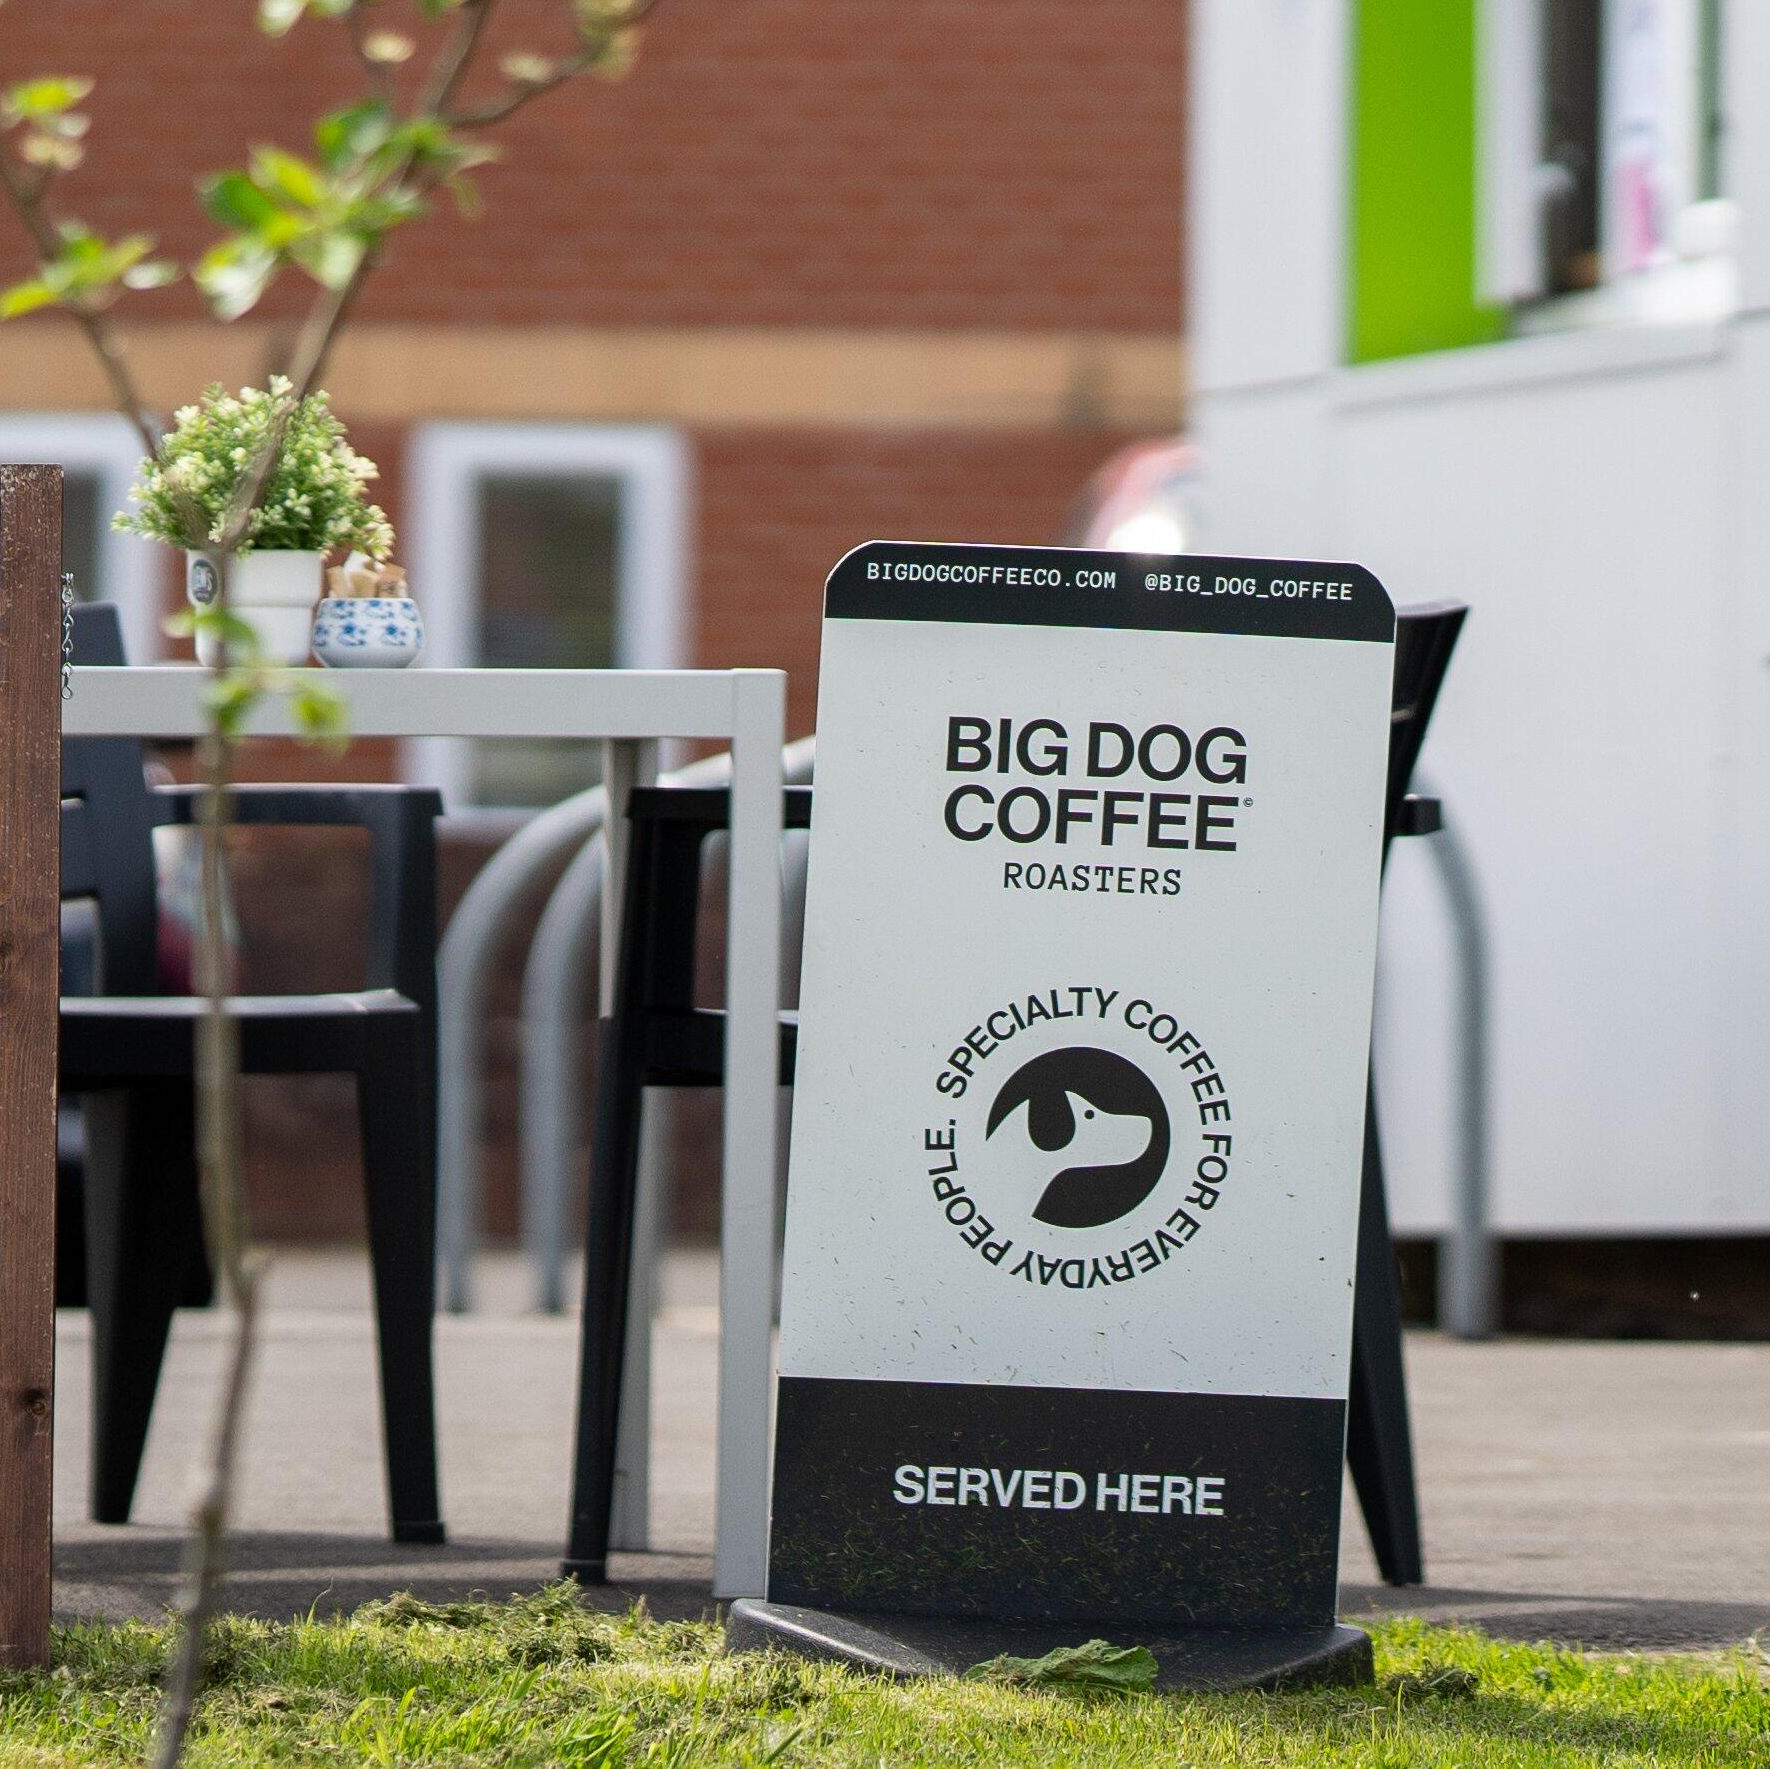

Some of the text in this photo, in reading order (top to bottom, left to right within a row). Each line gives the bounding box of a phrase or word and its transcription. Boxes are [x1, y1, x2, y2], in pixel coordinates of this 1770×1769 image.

[866, 562, 1353, 601] BIGDOGCOFFEECO.COM @BIG_DOG_COFFEE
[945, 716, 1248, 785] BIG DOG
[1003, 862, 1182, 896] ROASTERS
[923, 986, 1233, 1289] SPECIALTY COFFEE FOR EVERYDAY PEOPLE.
[892, 1464, 1227, 1516] SERVED HERE
